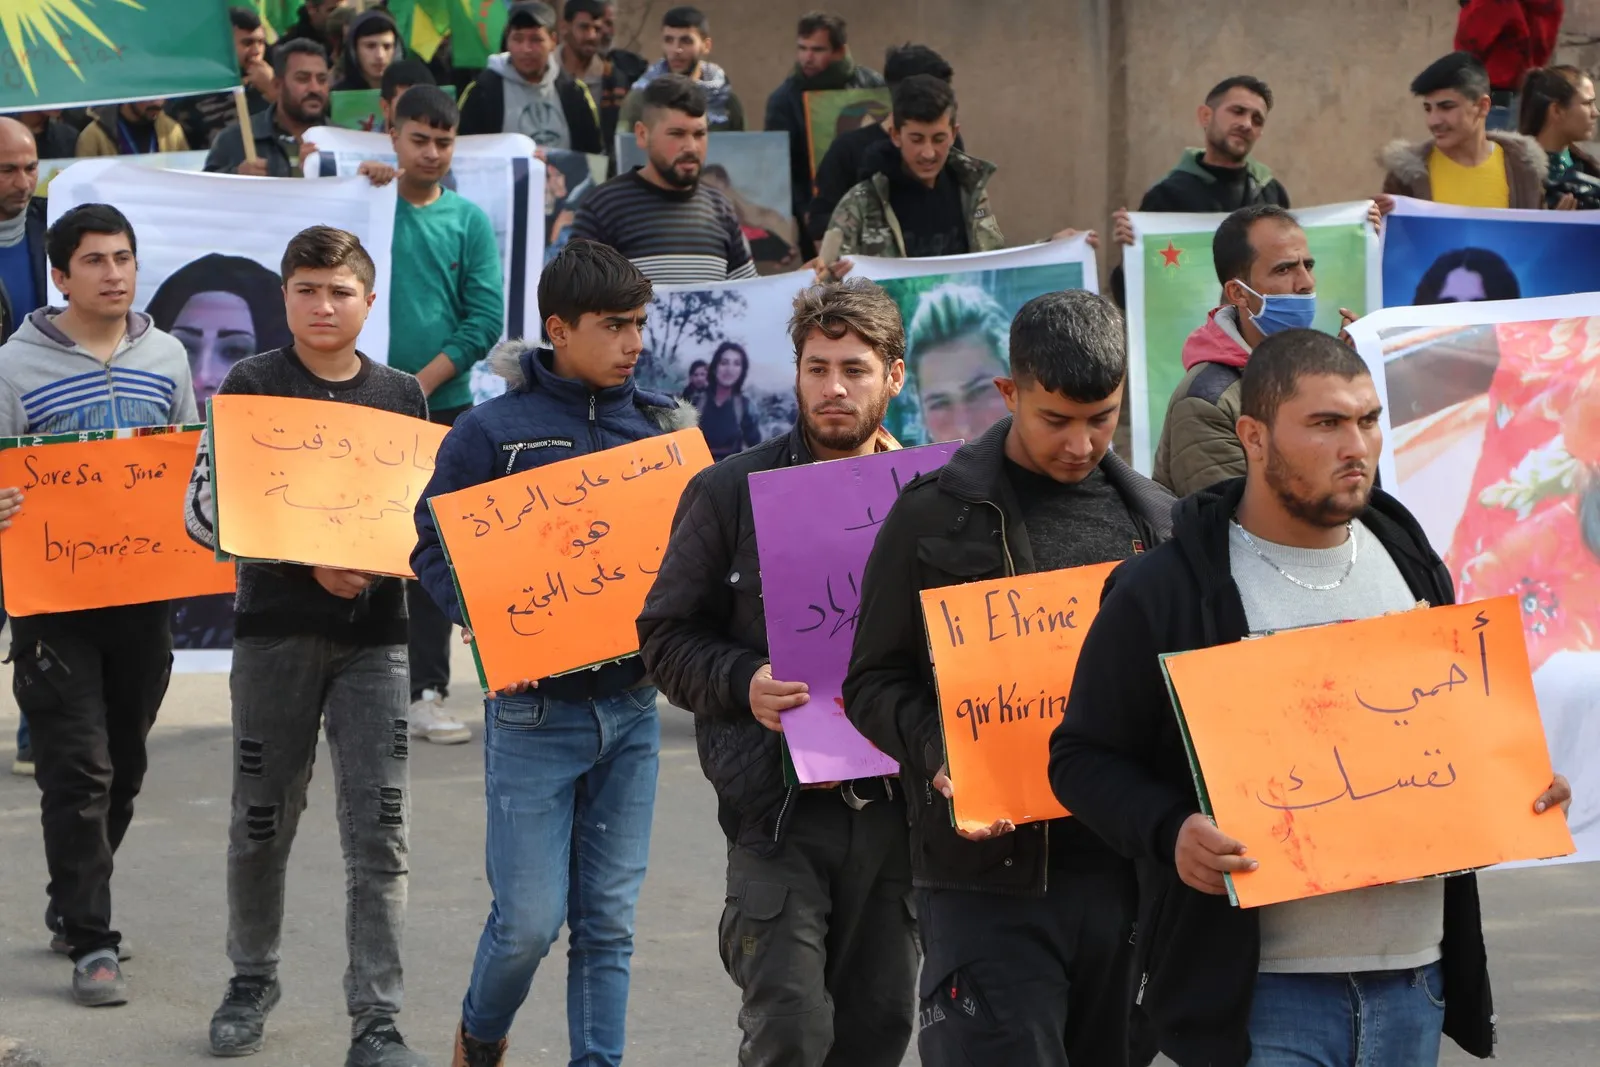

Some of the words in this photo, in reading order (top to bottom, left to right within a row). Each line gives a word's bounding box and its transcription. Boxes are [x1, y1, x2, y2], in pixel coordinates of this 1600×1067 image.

[83, 404, 108, 427] TOP
[252, 424, 352, 459] وقت
[527, 440, 548, 449] FASHION
[551, 439, 573, 448] FASHION
[124, 463, 168, 489] Jinê
[621, 442, 683, 481] العنف
[264, 471, 411, 525] لحرية
[553, 469, 611, 506] على
[462, 485, 549, 538] المرأة
[572, 520, 610, 559] هو
[573, 563, 626, 595] على
[507, 571, 568, 637] المجتمع
[940, 600, 965, 647] li
[985, 589, 1078, 641] Efrînê
[1355, 610, 1490, 726] أحمي
